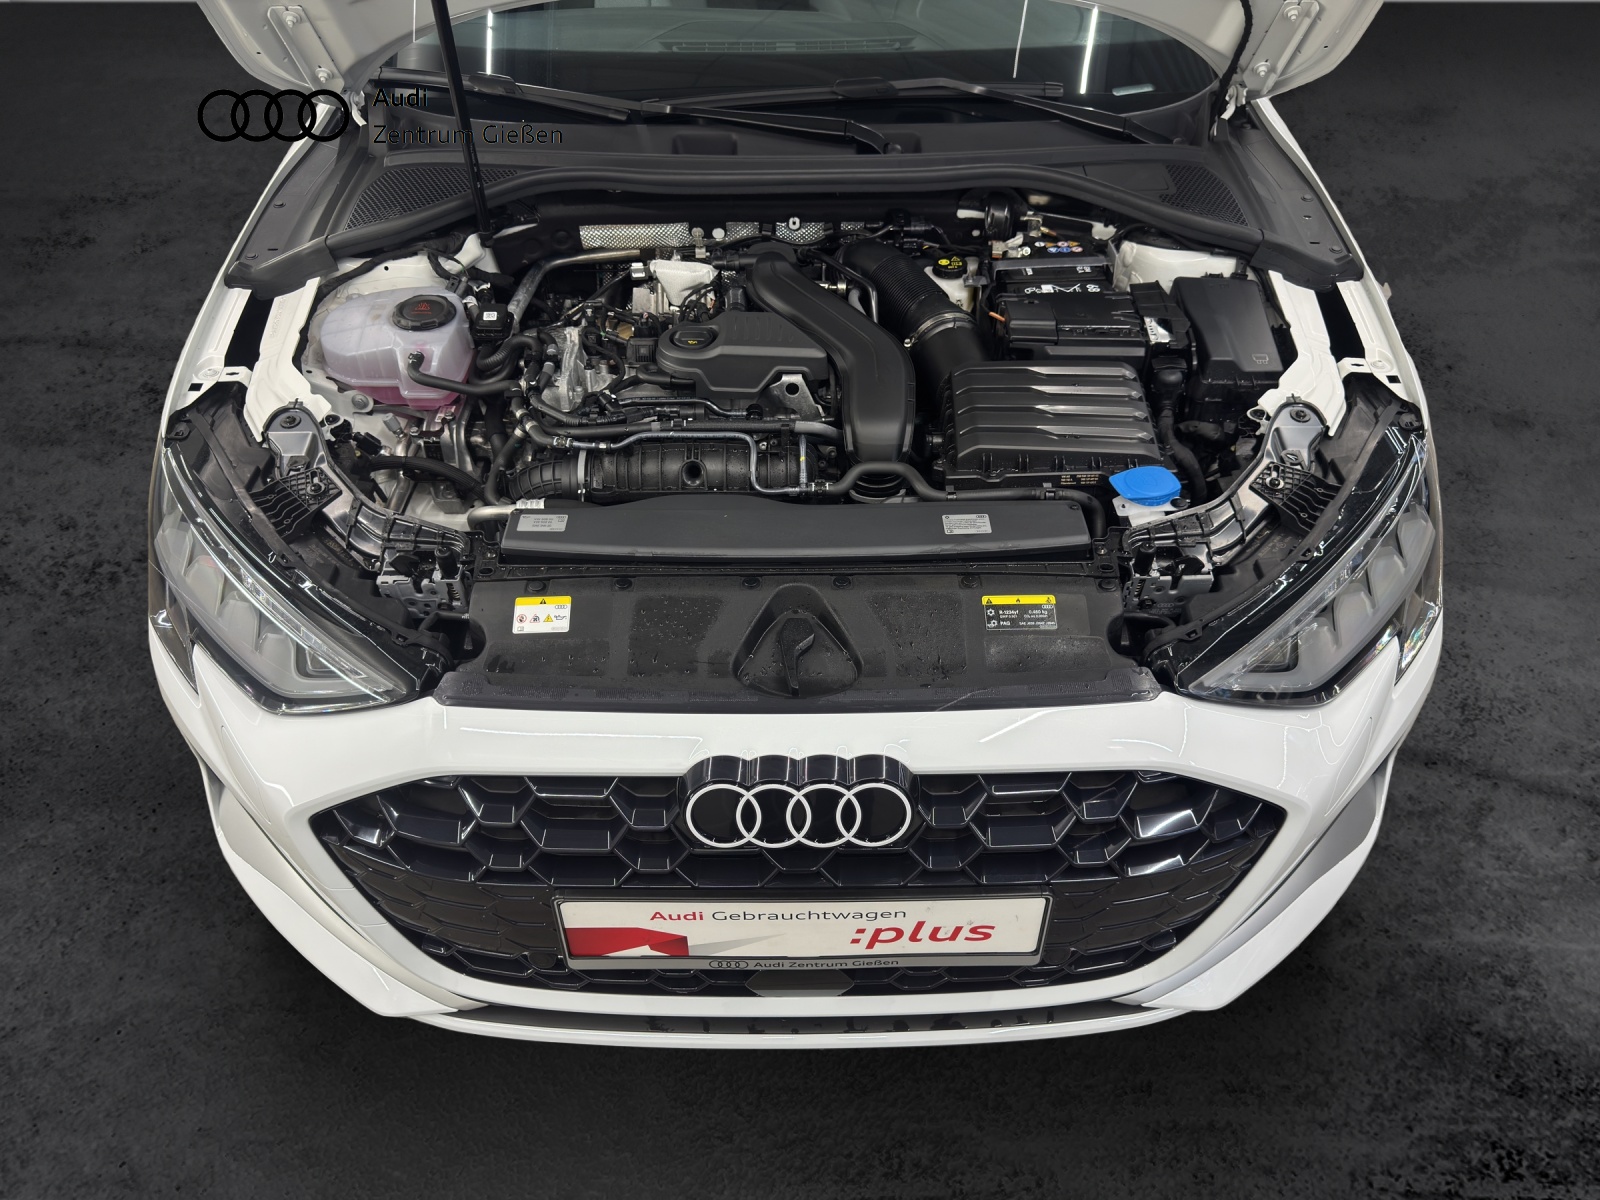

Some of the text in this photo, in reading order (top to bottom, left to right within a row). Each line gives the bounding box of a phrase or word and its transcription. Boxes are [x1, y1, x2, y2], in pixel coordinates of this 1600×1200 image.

[650, 911, 906, 921] Audi Gebrauchtwagen
[850, 921, 996, 949] :plus
[852, 959, 899, 967] Gießen
